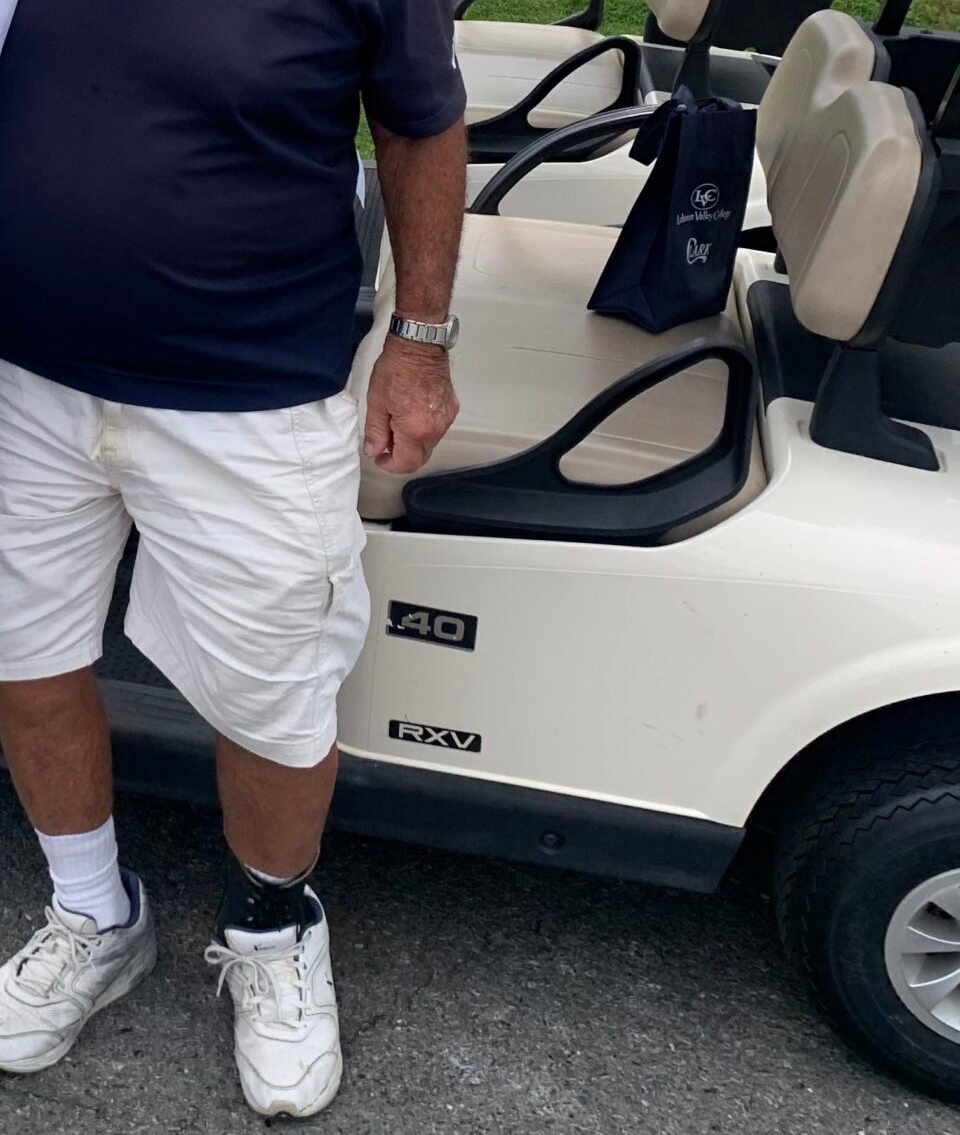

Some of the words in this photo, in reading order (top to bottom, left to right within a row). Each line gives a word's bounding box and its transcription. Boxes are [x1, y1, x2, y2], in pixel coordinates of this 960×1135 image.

[694, 189, 717, 207] LVC
[694, 210, 713, 222] Valley
[398, 723, 476, 749] RXV
